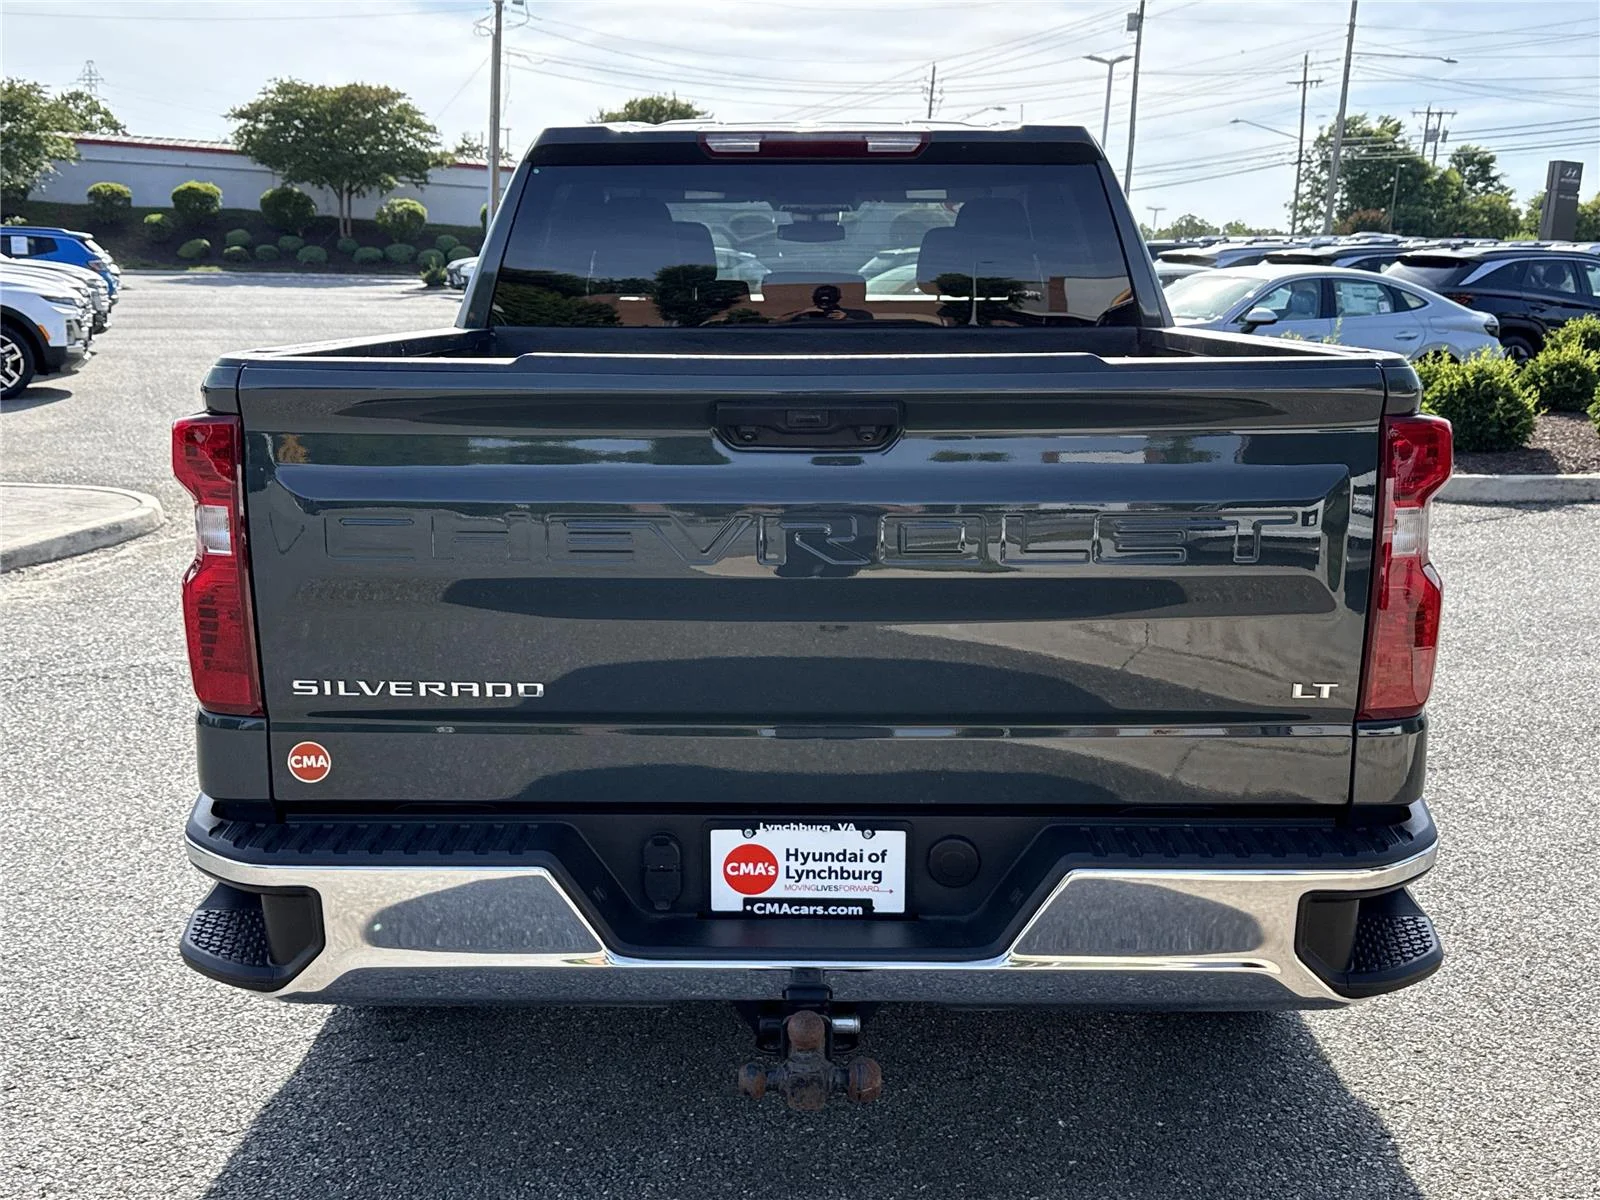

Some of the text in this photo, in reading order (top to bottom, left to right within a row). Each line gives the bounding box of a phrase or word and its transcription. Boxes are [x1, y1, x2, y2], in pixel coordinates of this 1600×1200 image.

[322, 510, 1299, 565] CHEVROLET
[292, 680, 545, 698] SILVERADO
[1292, 683, 1339, 698] LT
[290, 755, 329, 769] CMA
[838, 823, 856, 831] VA
[785, 848, 888, 865] Hyundai of
[726, 862, 776, 876] CMA's
[785, 865, 883, 884] Lynchburg
